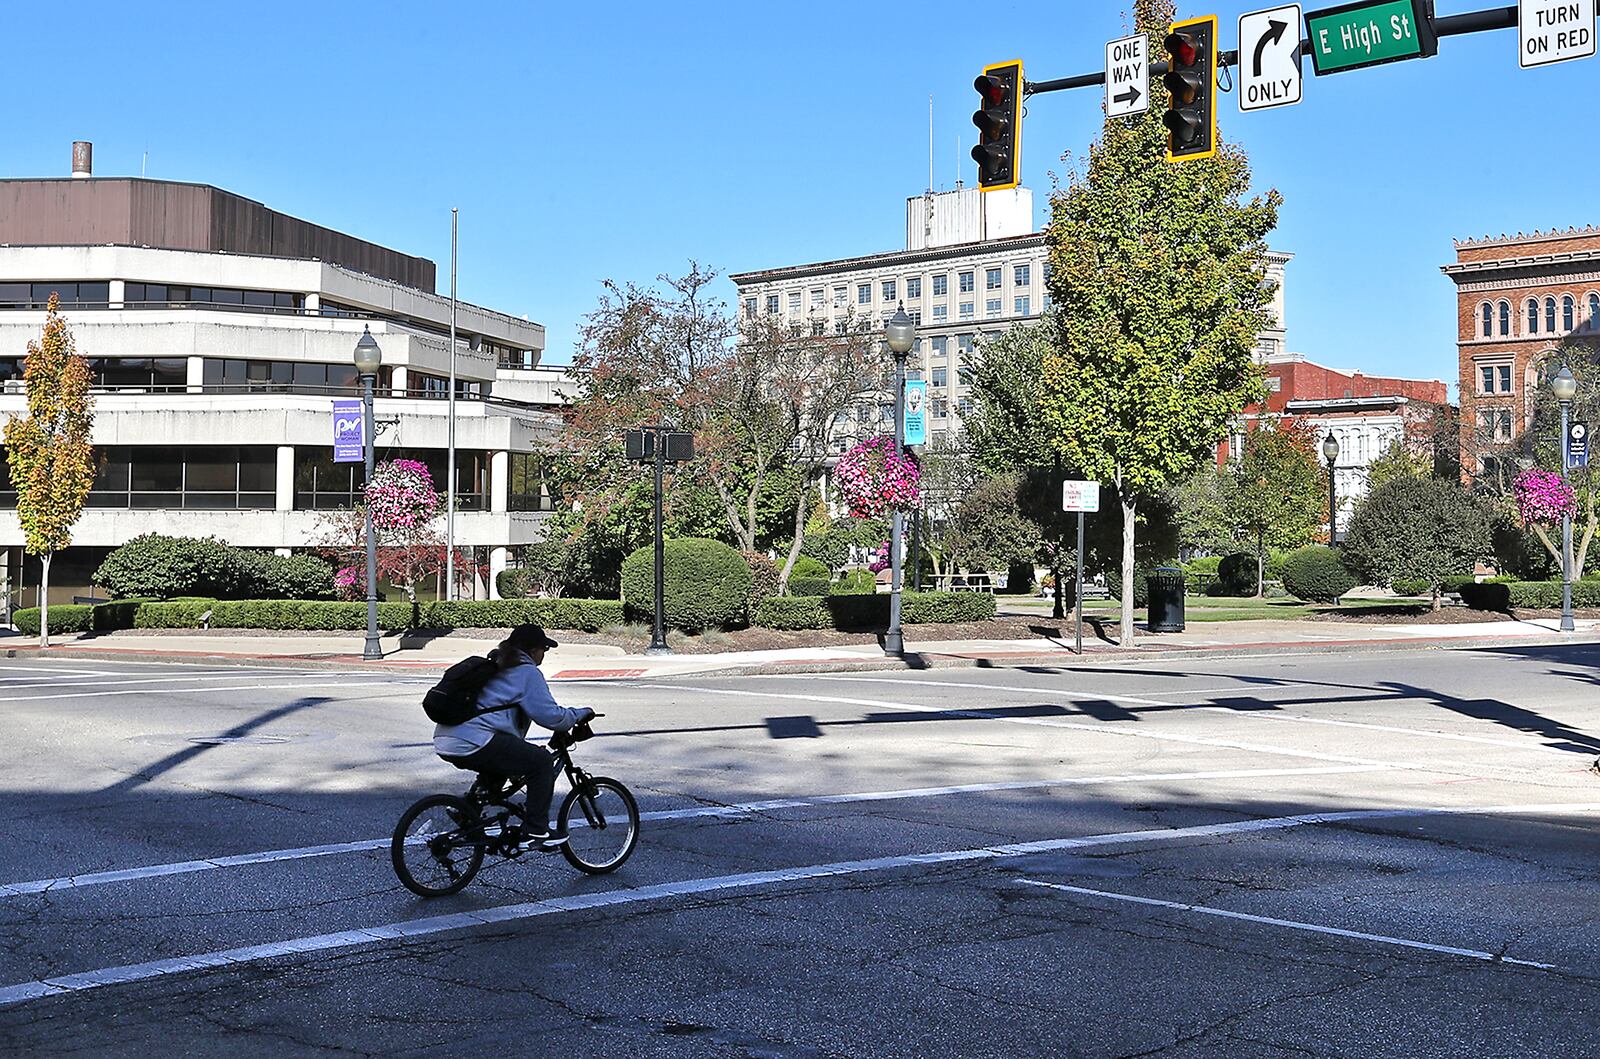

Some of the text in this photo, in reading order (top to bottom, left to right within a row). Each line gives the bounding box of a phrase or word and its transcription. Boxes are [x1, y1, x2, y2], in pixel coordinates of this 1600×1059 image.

[1536, 3, 1579, 27] TURN
[1319, 13, 1411, 55] E High St
[1527, 28, 1589, 54] ON RED
[1113, 41, 1140, 61] ONE
[1113, 62, 1141, 84] WAY
[1248, 78, 1292, 103] ONLY
